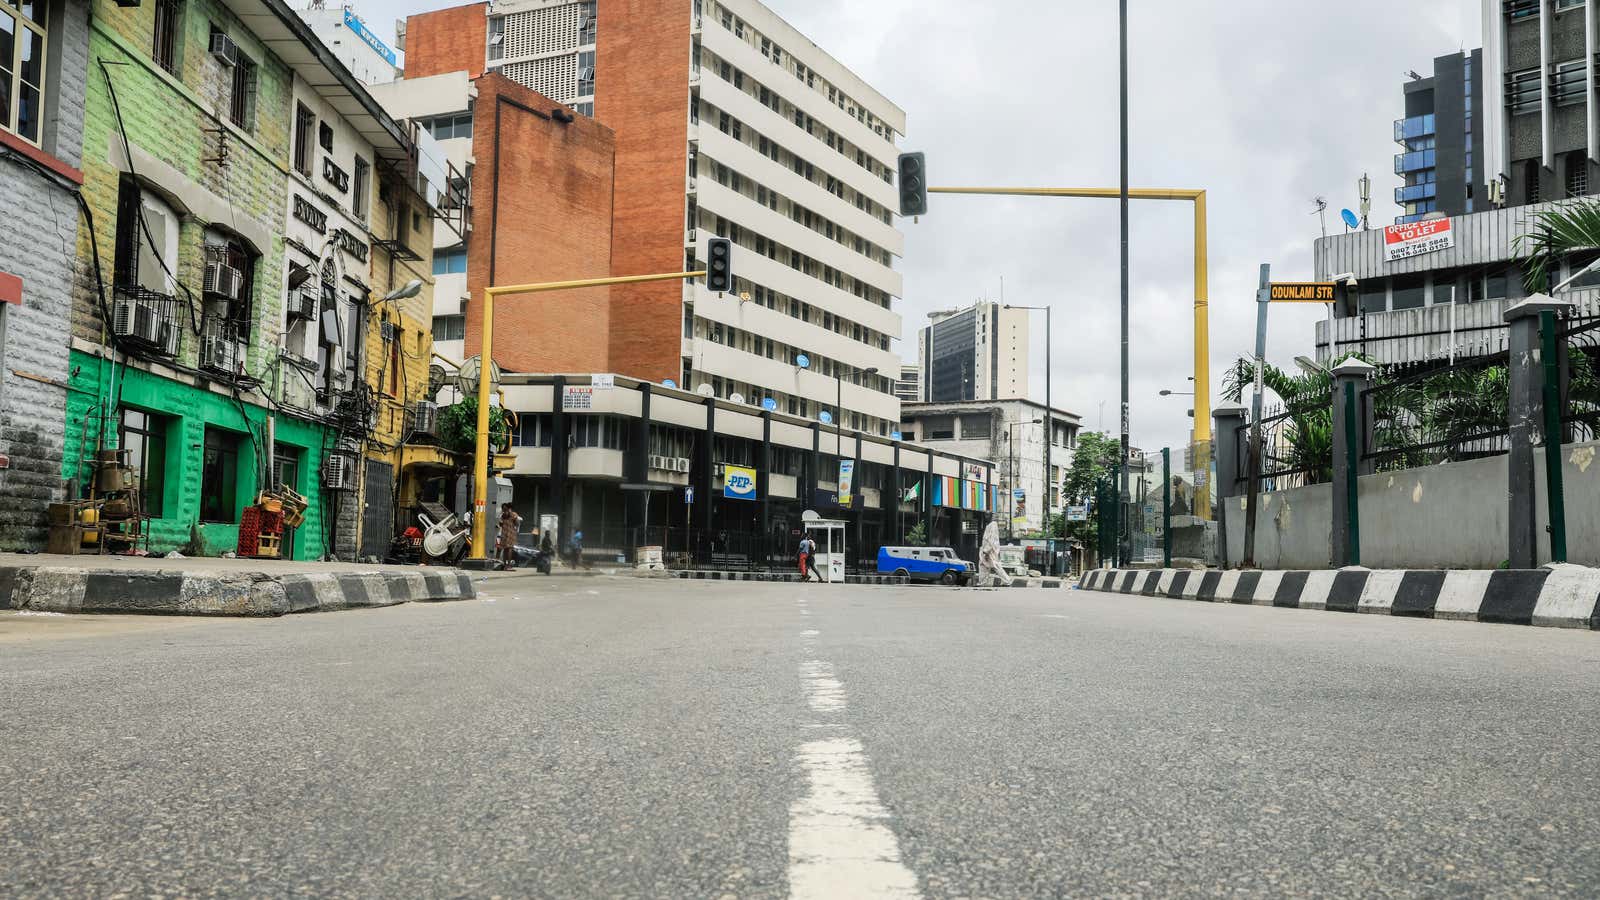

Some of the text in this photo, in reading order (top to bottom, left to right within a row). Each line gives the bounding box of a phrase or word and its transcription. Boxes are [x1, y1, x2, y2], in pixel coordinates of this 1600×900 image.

[1388, 223, 1418, 233] OFFICE
[1400, 224, 1436, 240] TO LET
[1272, 286, 1333, 298] ODUNLAMI STR
